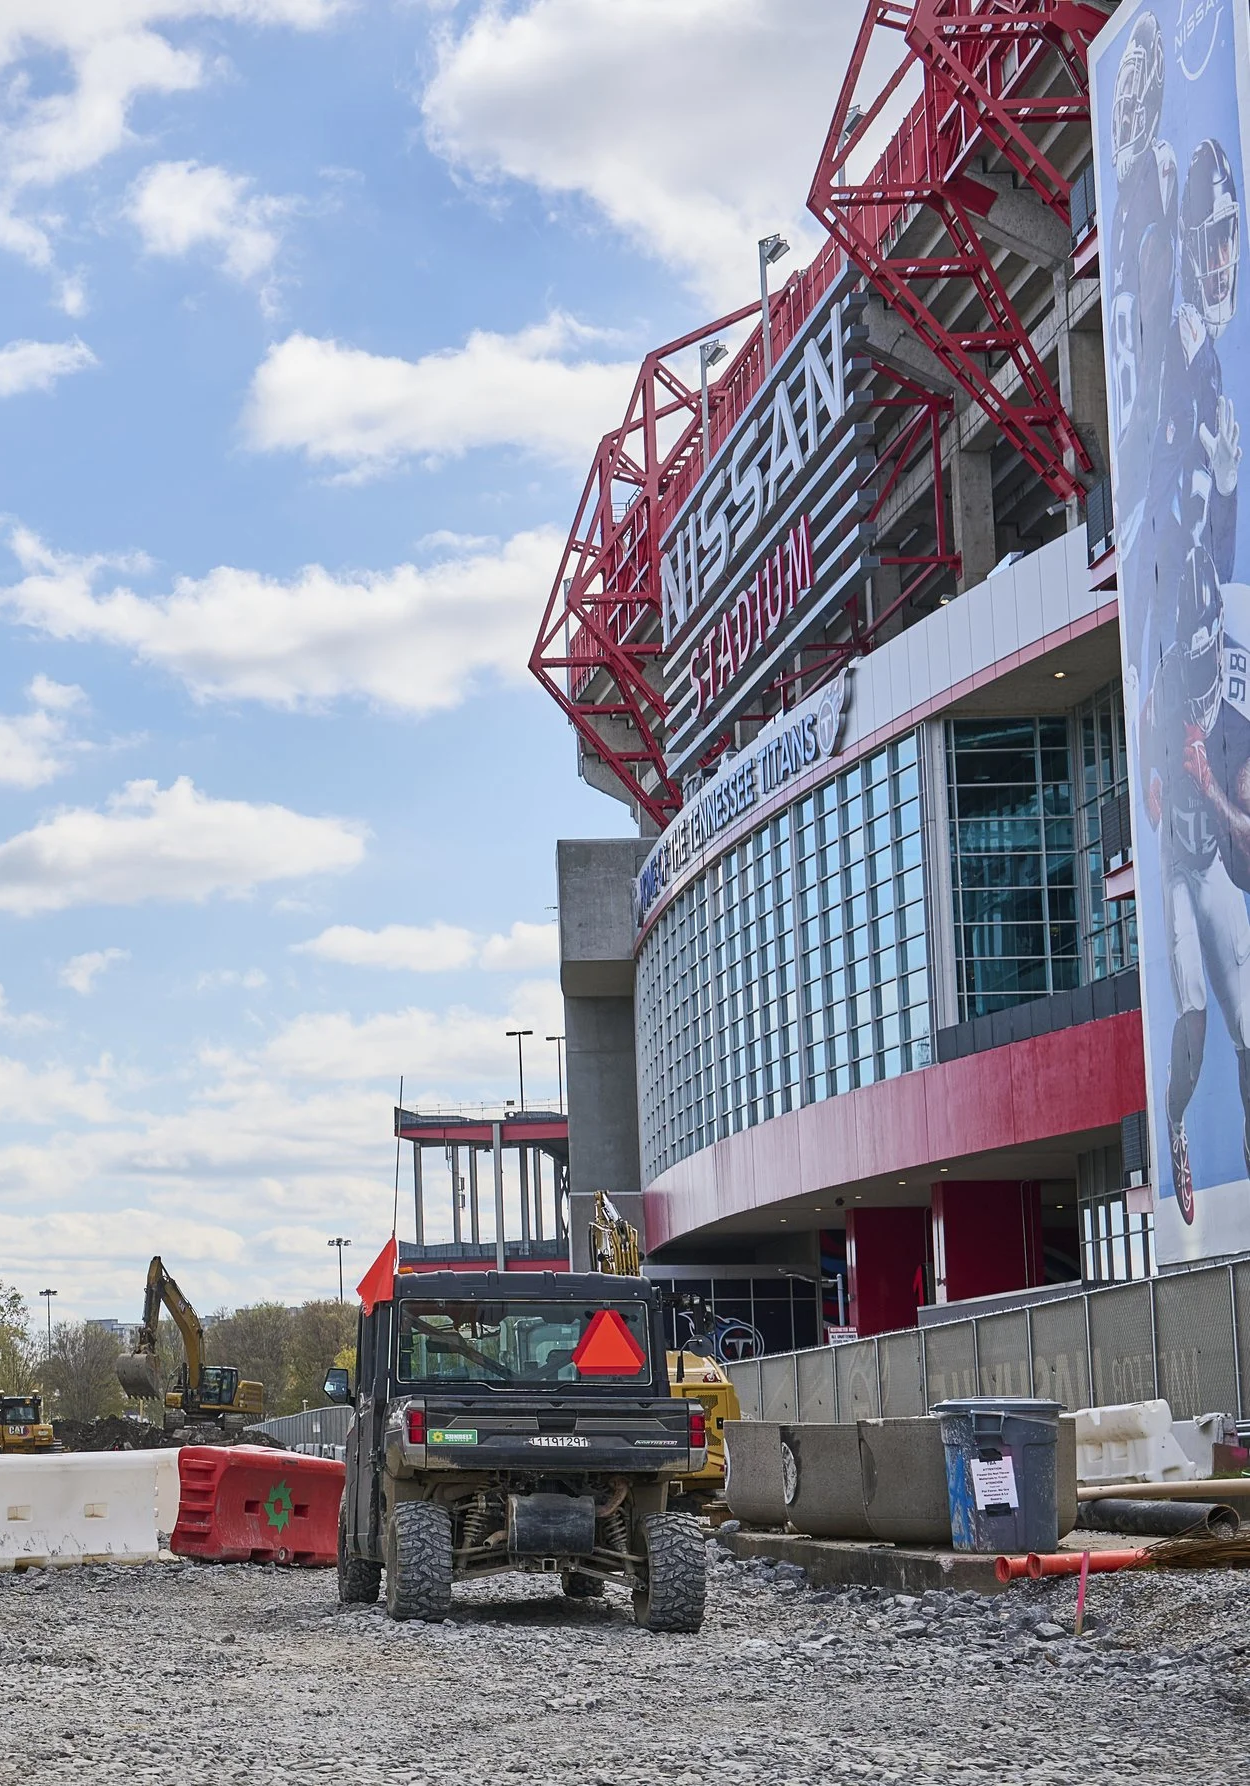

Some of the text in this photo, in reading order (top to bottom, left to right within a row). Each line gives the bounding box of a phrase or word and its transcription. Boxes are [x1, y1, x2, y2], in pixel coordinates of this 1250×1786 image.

[1174, 0, 1218, 54] NISSA
[660, 302, 846, 645] NISSAN
[689, 514, 814, 718] STADIUM
[670, 820, 688, 872] THE
[688, 758, 755, 853] TENNESSEE
[757, 713, 817, 794] TITANS
[9, 1426, 25, 1435] CAT
